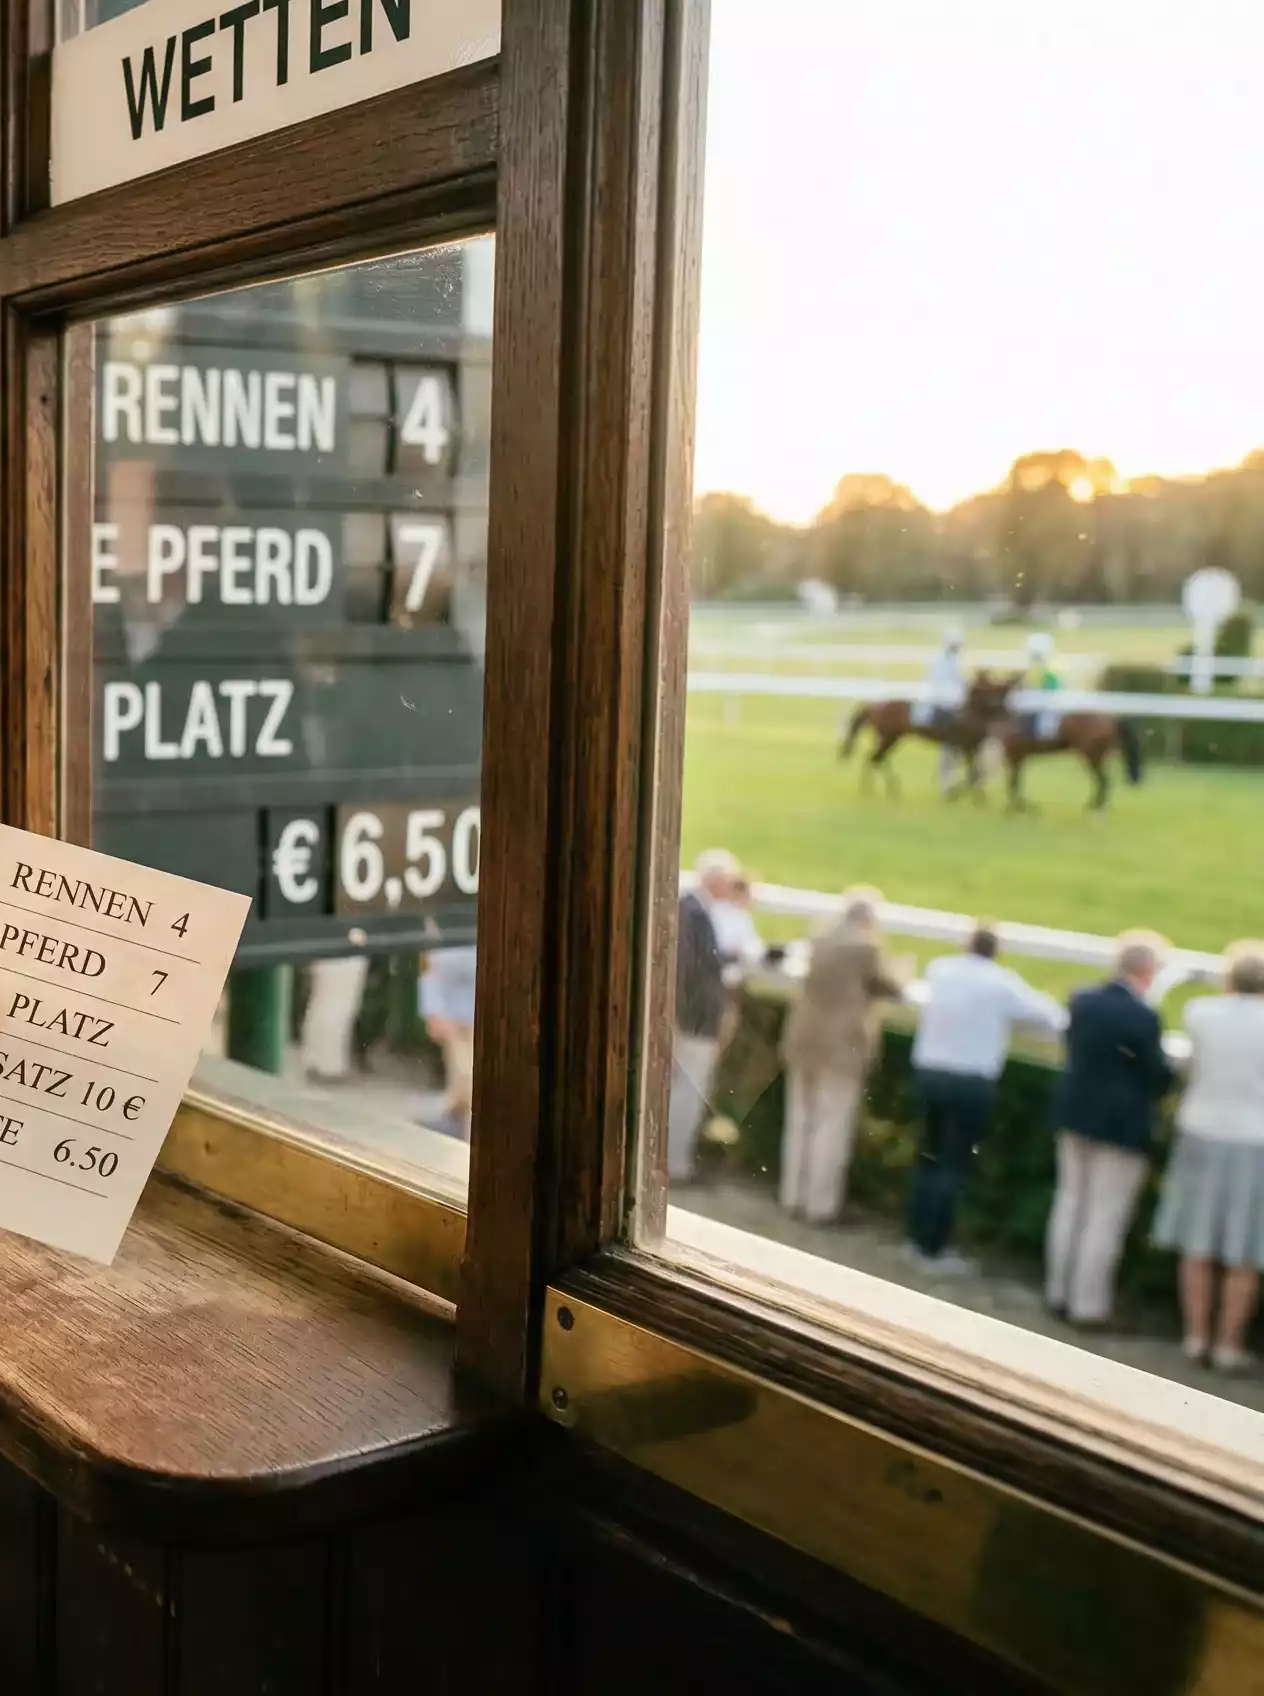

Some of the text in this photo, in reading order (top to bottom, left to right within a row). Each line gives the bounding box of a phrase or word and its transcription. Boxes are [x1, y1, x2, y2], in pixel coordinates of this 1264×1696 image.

[102, 360, 448, 465] RENNEN 4
[146, 523, 333, 606] PFERD
[397, 524, 443, 612] 7
[102, 680, 295, 762] PLATZ
[272, 806, 481, 910] € 6,50
[8, 861, 190, 939] RENNEN 4
[5, 992, 116, 1048] PLATZ
[149, 969, 169, 996] 7
[80, 1081, 116, 1112] 10
[122, 1095, 146, 1121] €
[52, 1138, 119, 1178] 6.50
